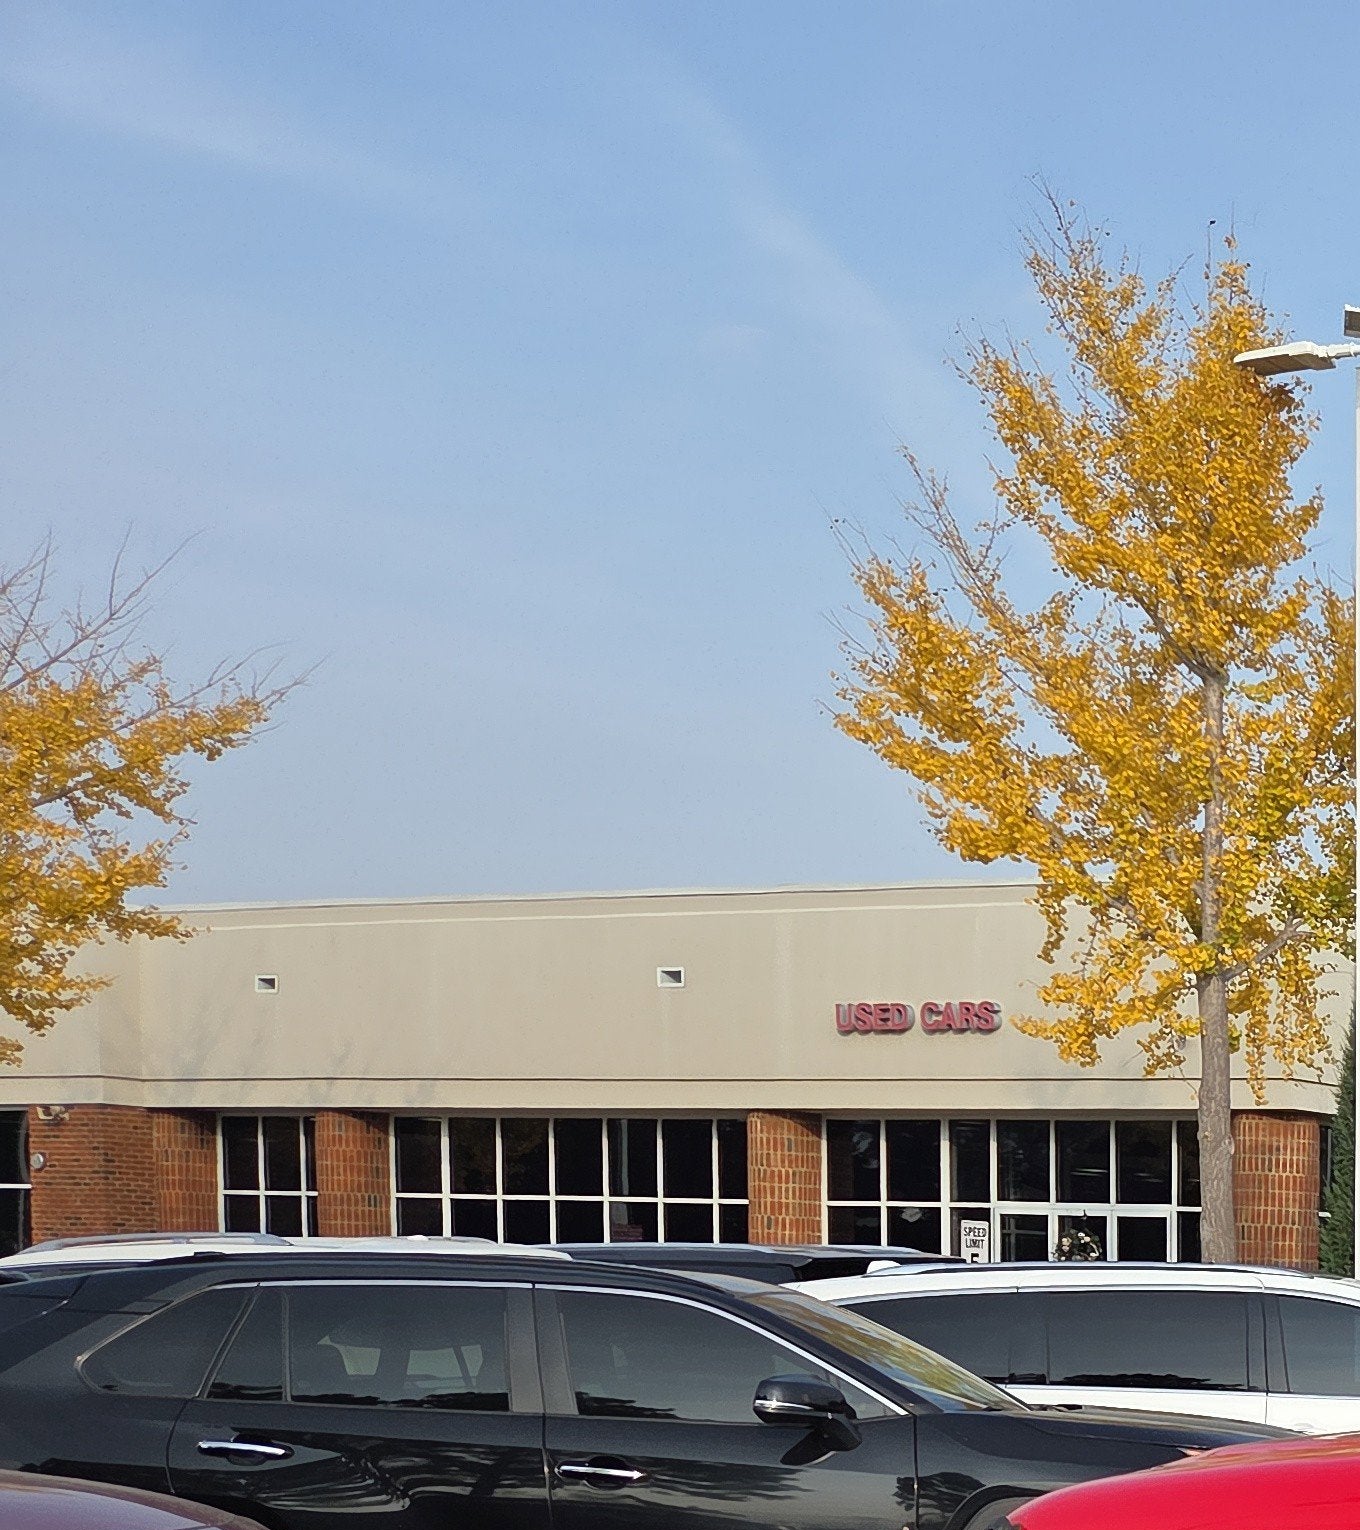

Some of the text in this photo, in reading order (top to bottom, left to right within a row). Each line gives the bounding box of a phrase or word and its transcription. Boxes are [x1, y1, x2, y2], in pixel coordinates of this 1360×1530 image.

[835, 1001, 1001, 1032] USED CARS
[963, 1226, 987, 1237] SPEED
[965, 1238, 985, 1249] LIMIT
